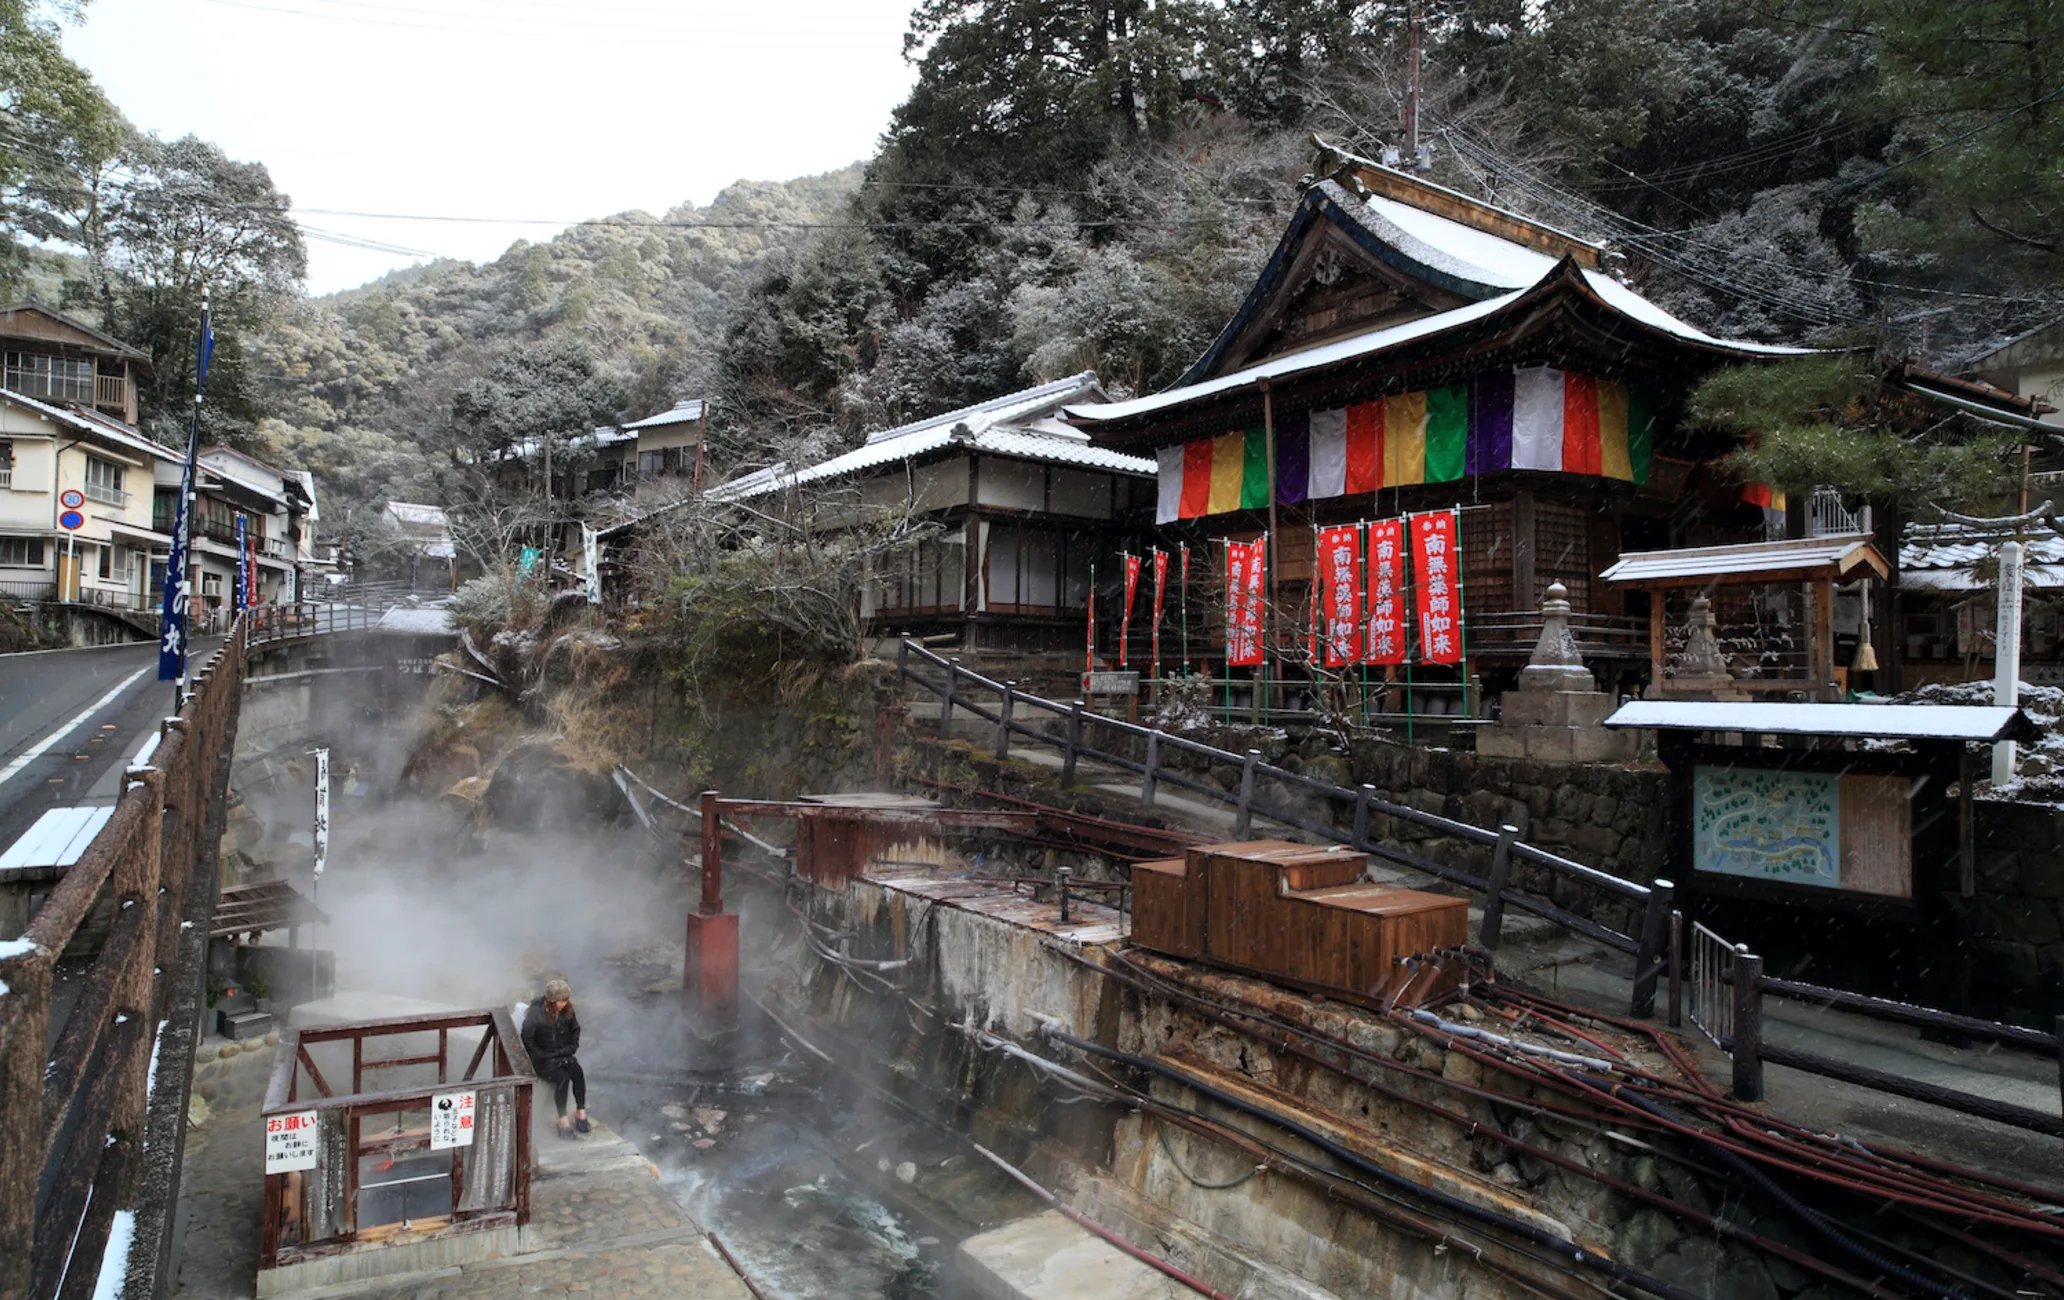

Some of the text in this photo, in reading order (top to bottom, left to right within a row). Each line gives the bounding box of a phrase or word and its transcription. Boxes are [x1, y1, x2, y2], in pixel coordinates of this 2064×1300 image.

[65, 494, 80, 505] 30
[1375, 540, 1395, 657] 南無薬師如来
[1423, 533, 1452, 656] 南無薬師如来
[267, 1115, 317, 1132] お願い
[459, 1095, 473, 1129] 注意
[267, 1149, 314, 1161] お願いします
